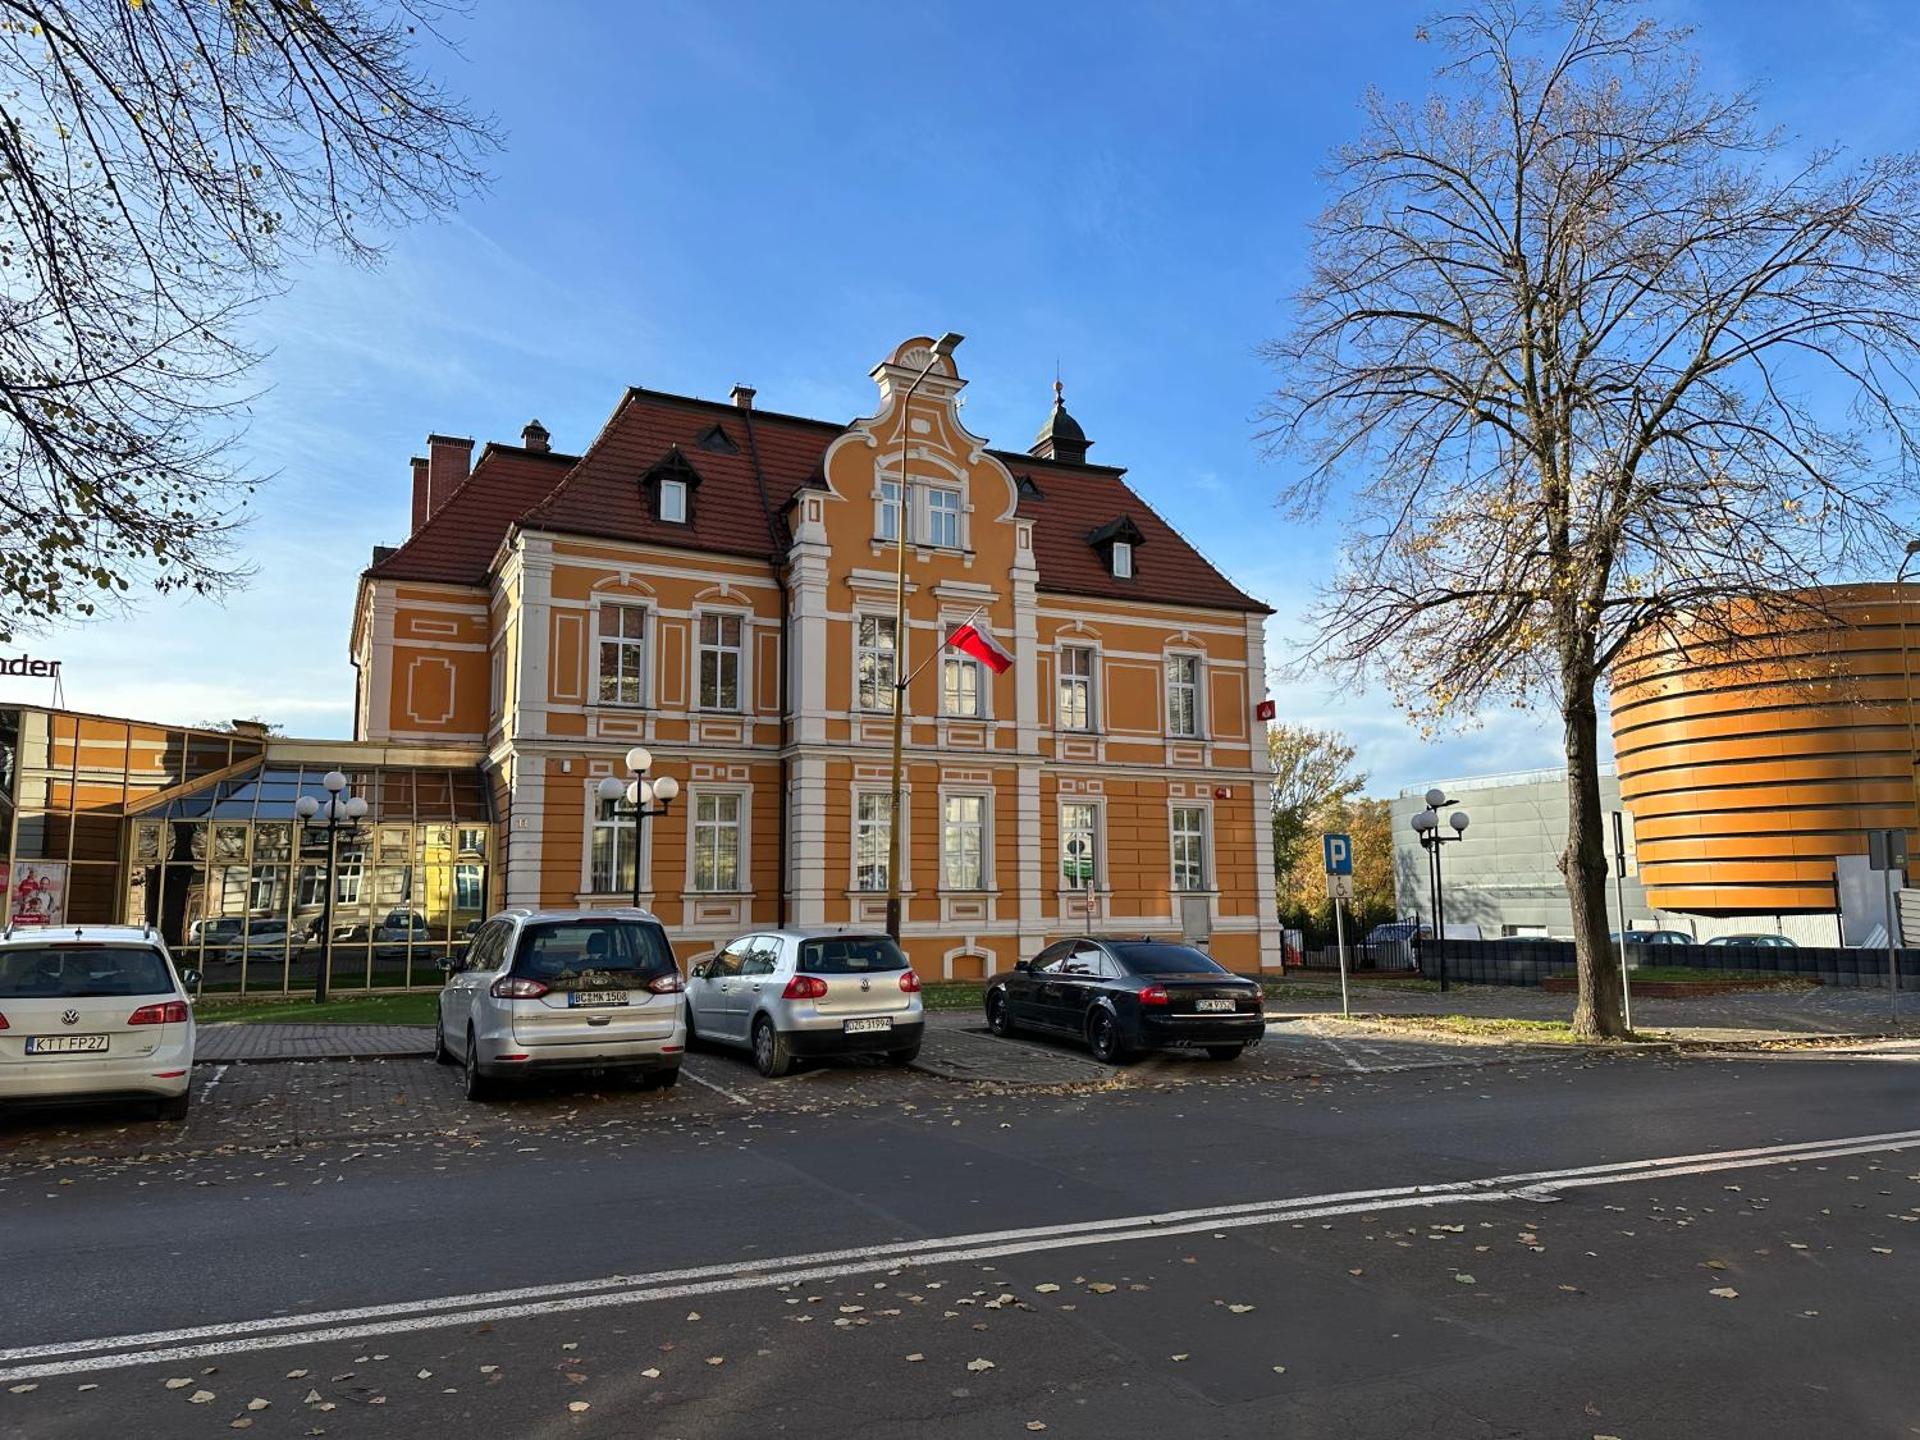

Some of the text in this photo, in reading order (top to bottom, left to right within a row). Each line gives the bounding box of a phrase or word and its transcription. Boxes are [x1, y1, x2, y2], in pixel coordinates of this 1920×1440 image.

[1330, 839, 1346, 868] P
[36, 1036, 105, 1051] KTT FP27
